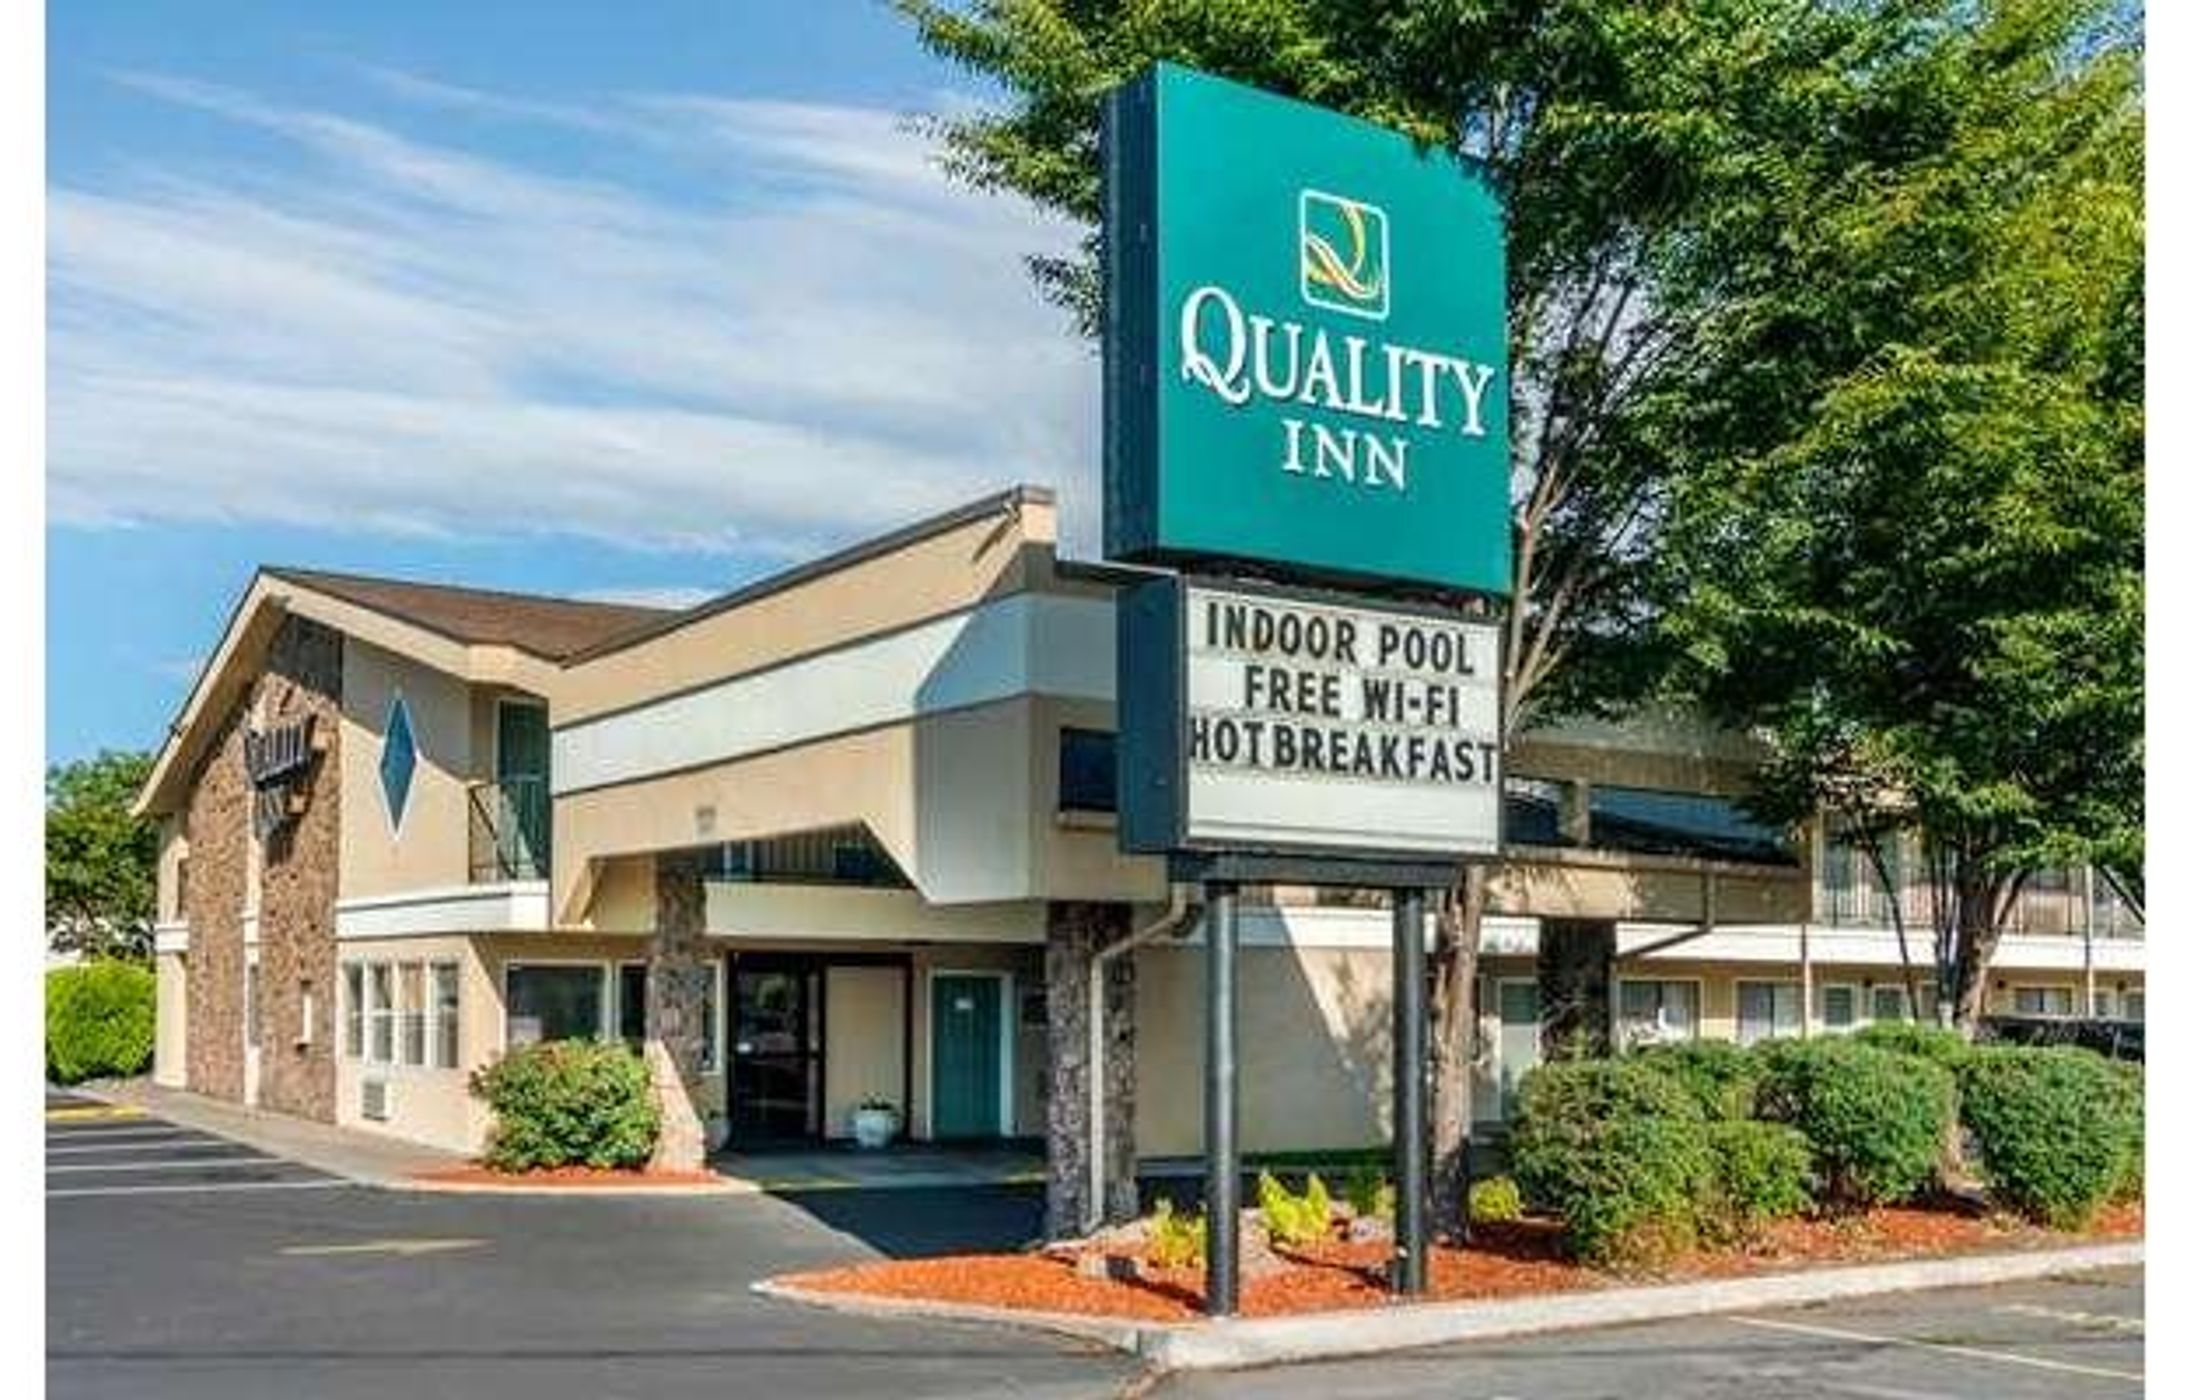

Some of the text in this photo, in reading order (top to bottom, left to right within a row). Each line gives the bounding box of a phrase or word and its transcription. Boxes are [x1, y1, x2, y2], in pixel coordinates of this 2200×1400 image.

[1180, 286, 1494, 436] QUALITY
[1282, 419, 1408, 488] INN
[1206, 602, 1474, 675] INDOOR POOL
[1245, 664, 1460, 727] FREE WI-FI
